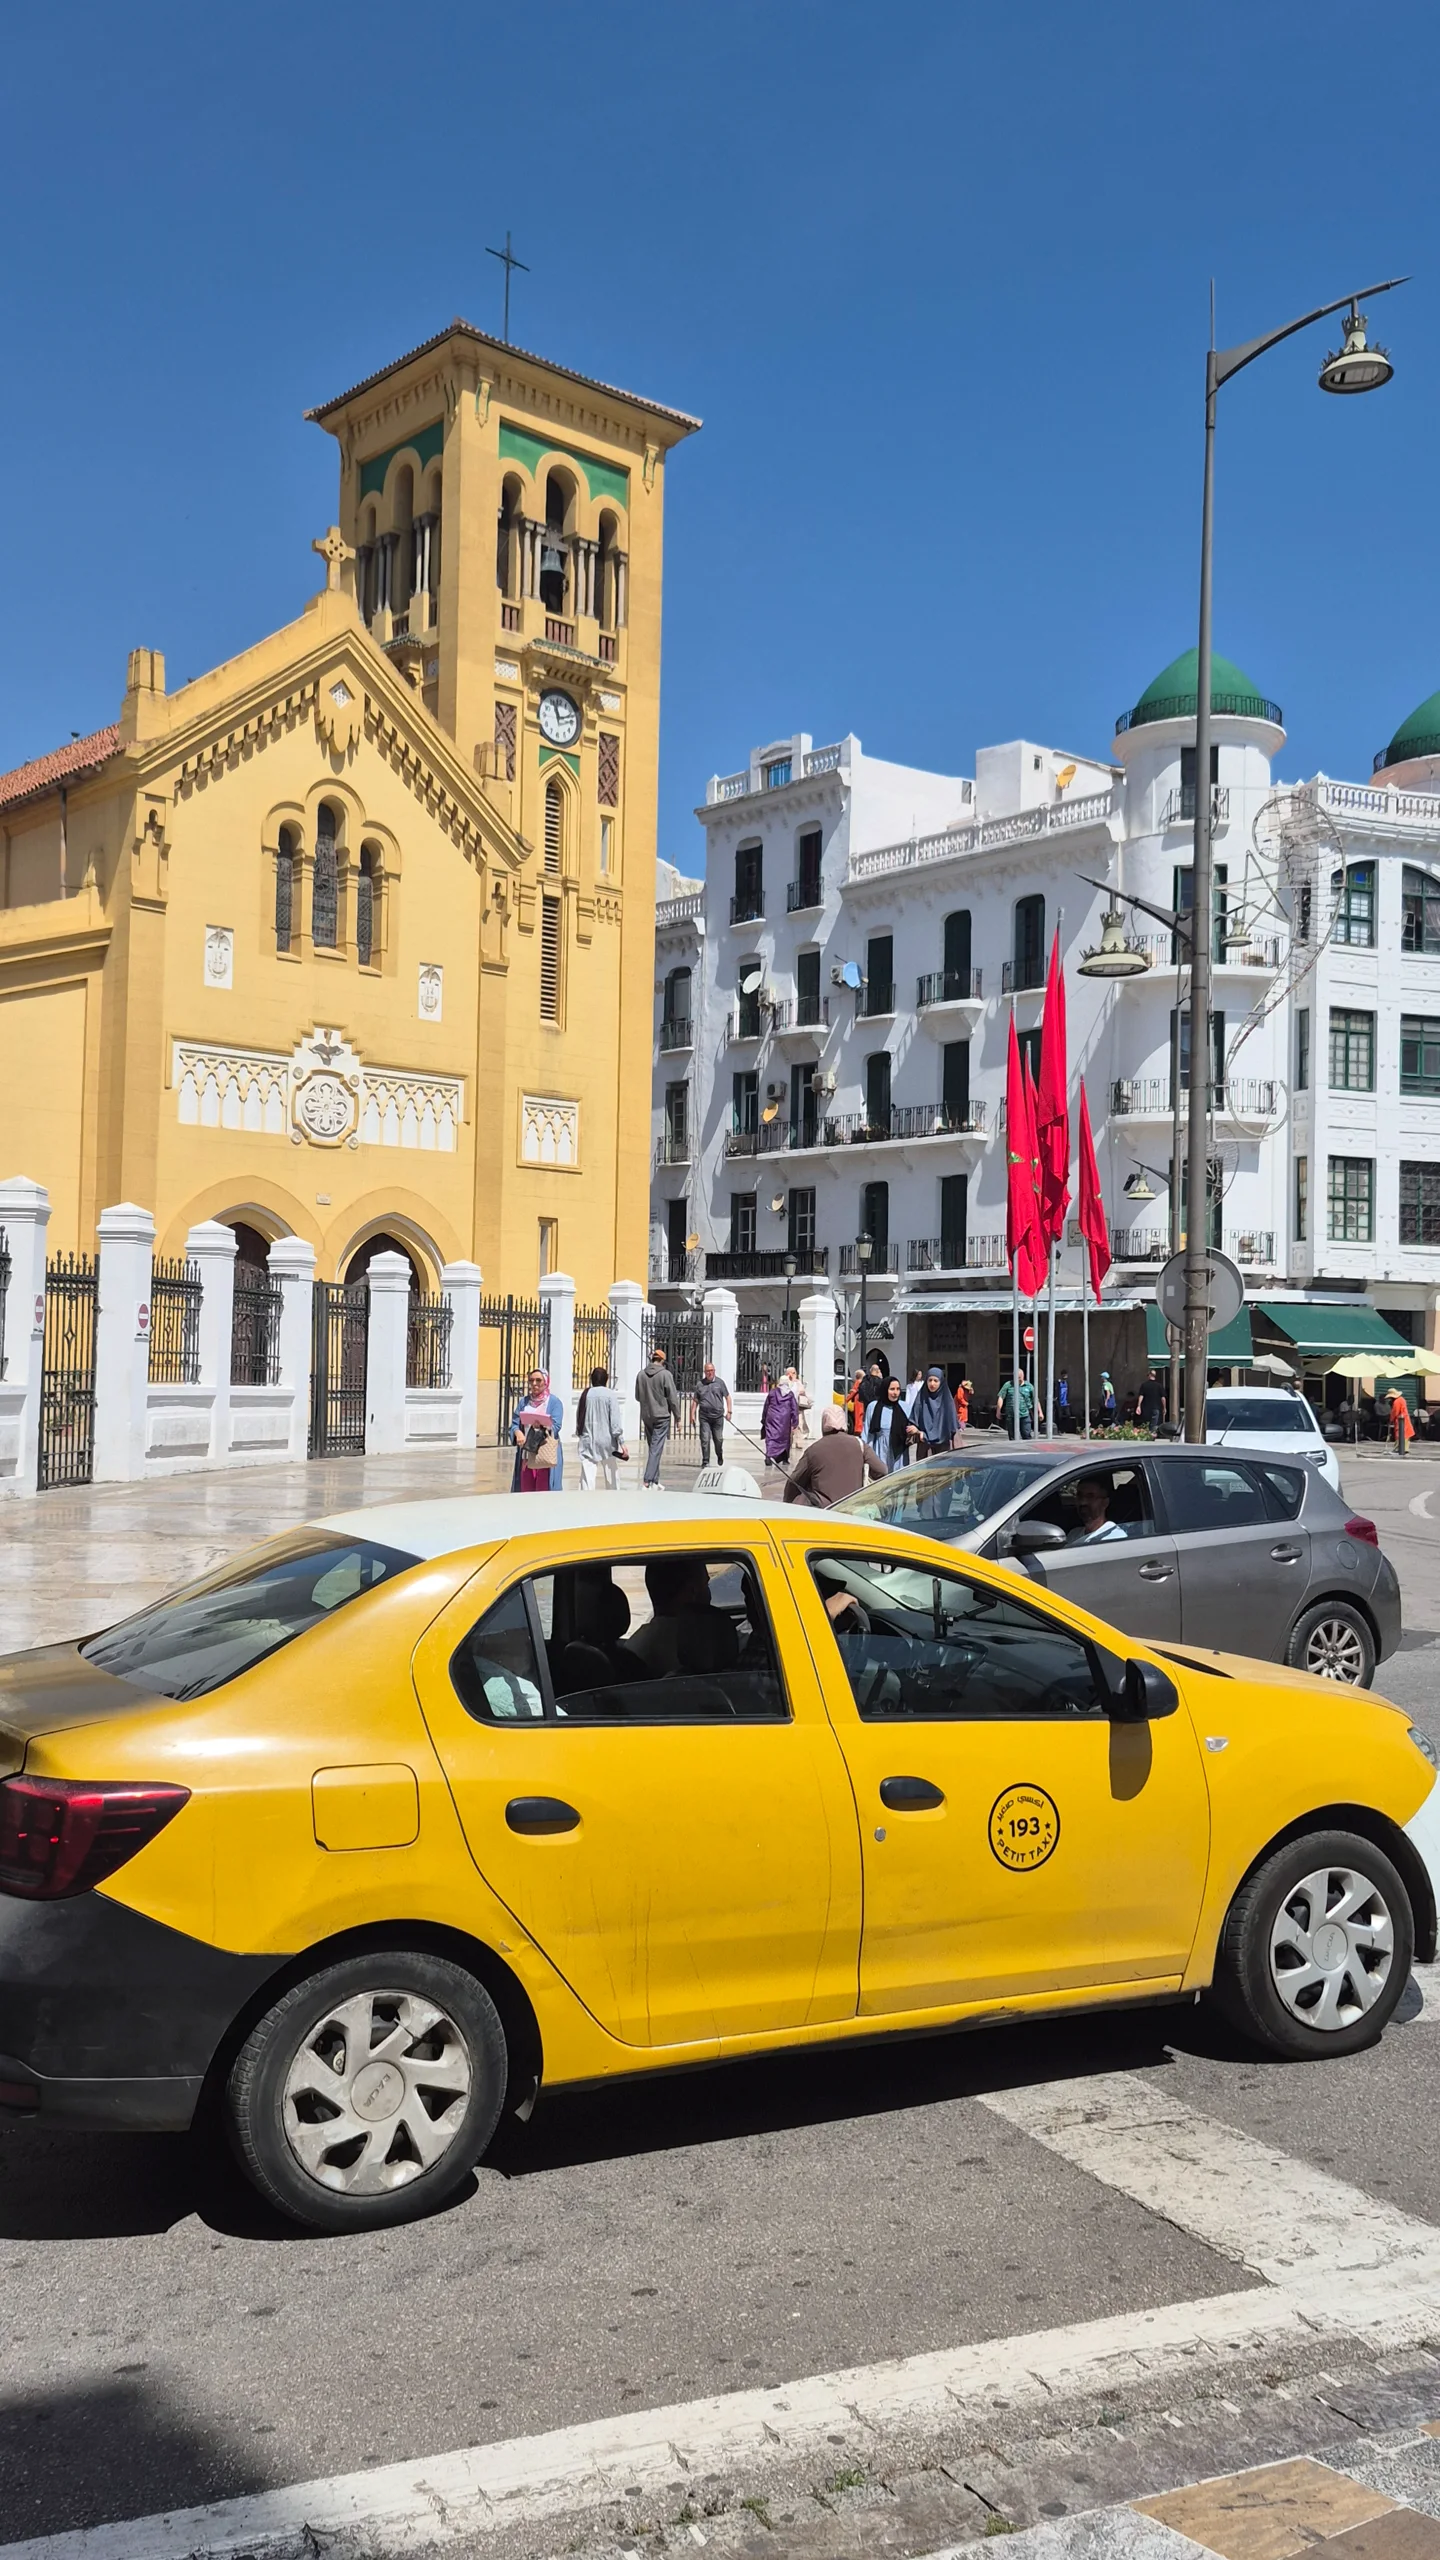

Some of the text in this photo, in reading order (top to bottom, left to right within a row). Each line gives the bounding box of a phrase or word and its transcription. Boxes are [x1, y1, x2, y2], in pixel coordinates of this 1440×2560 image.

[698, 1472, 723, 1488] TAXI
[1008, 1816, 1041, 1838] 193
[996, 1832, 1053, 1863] PETIT TAXI
